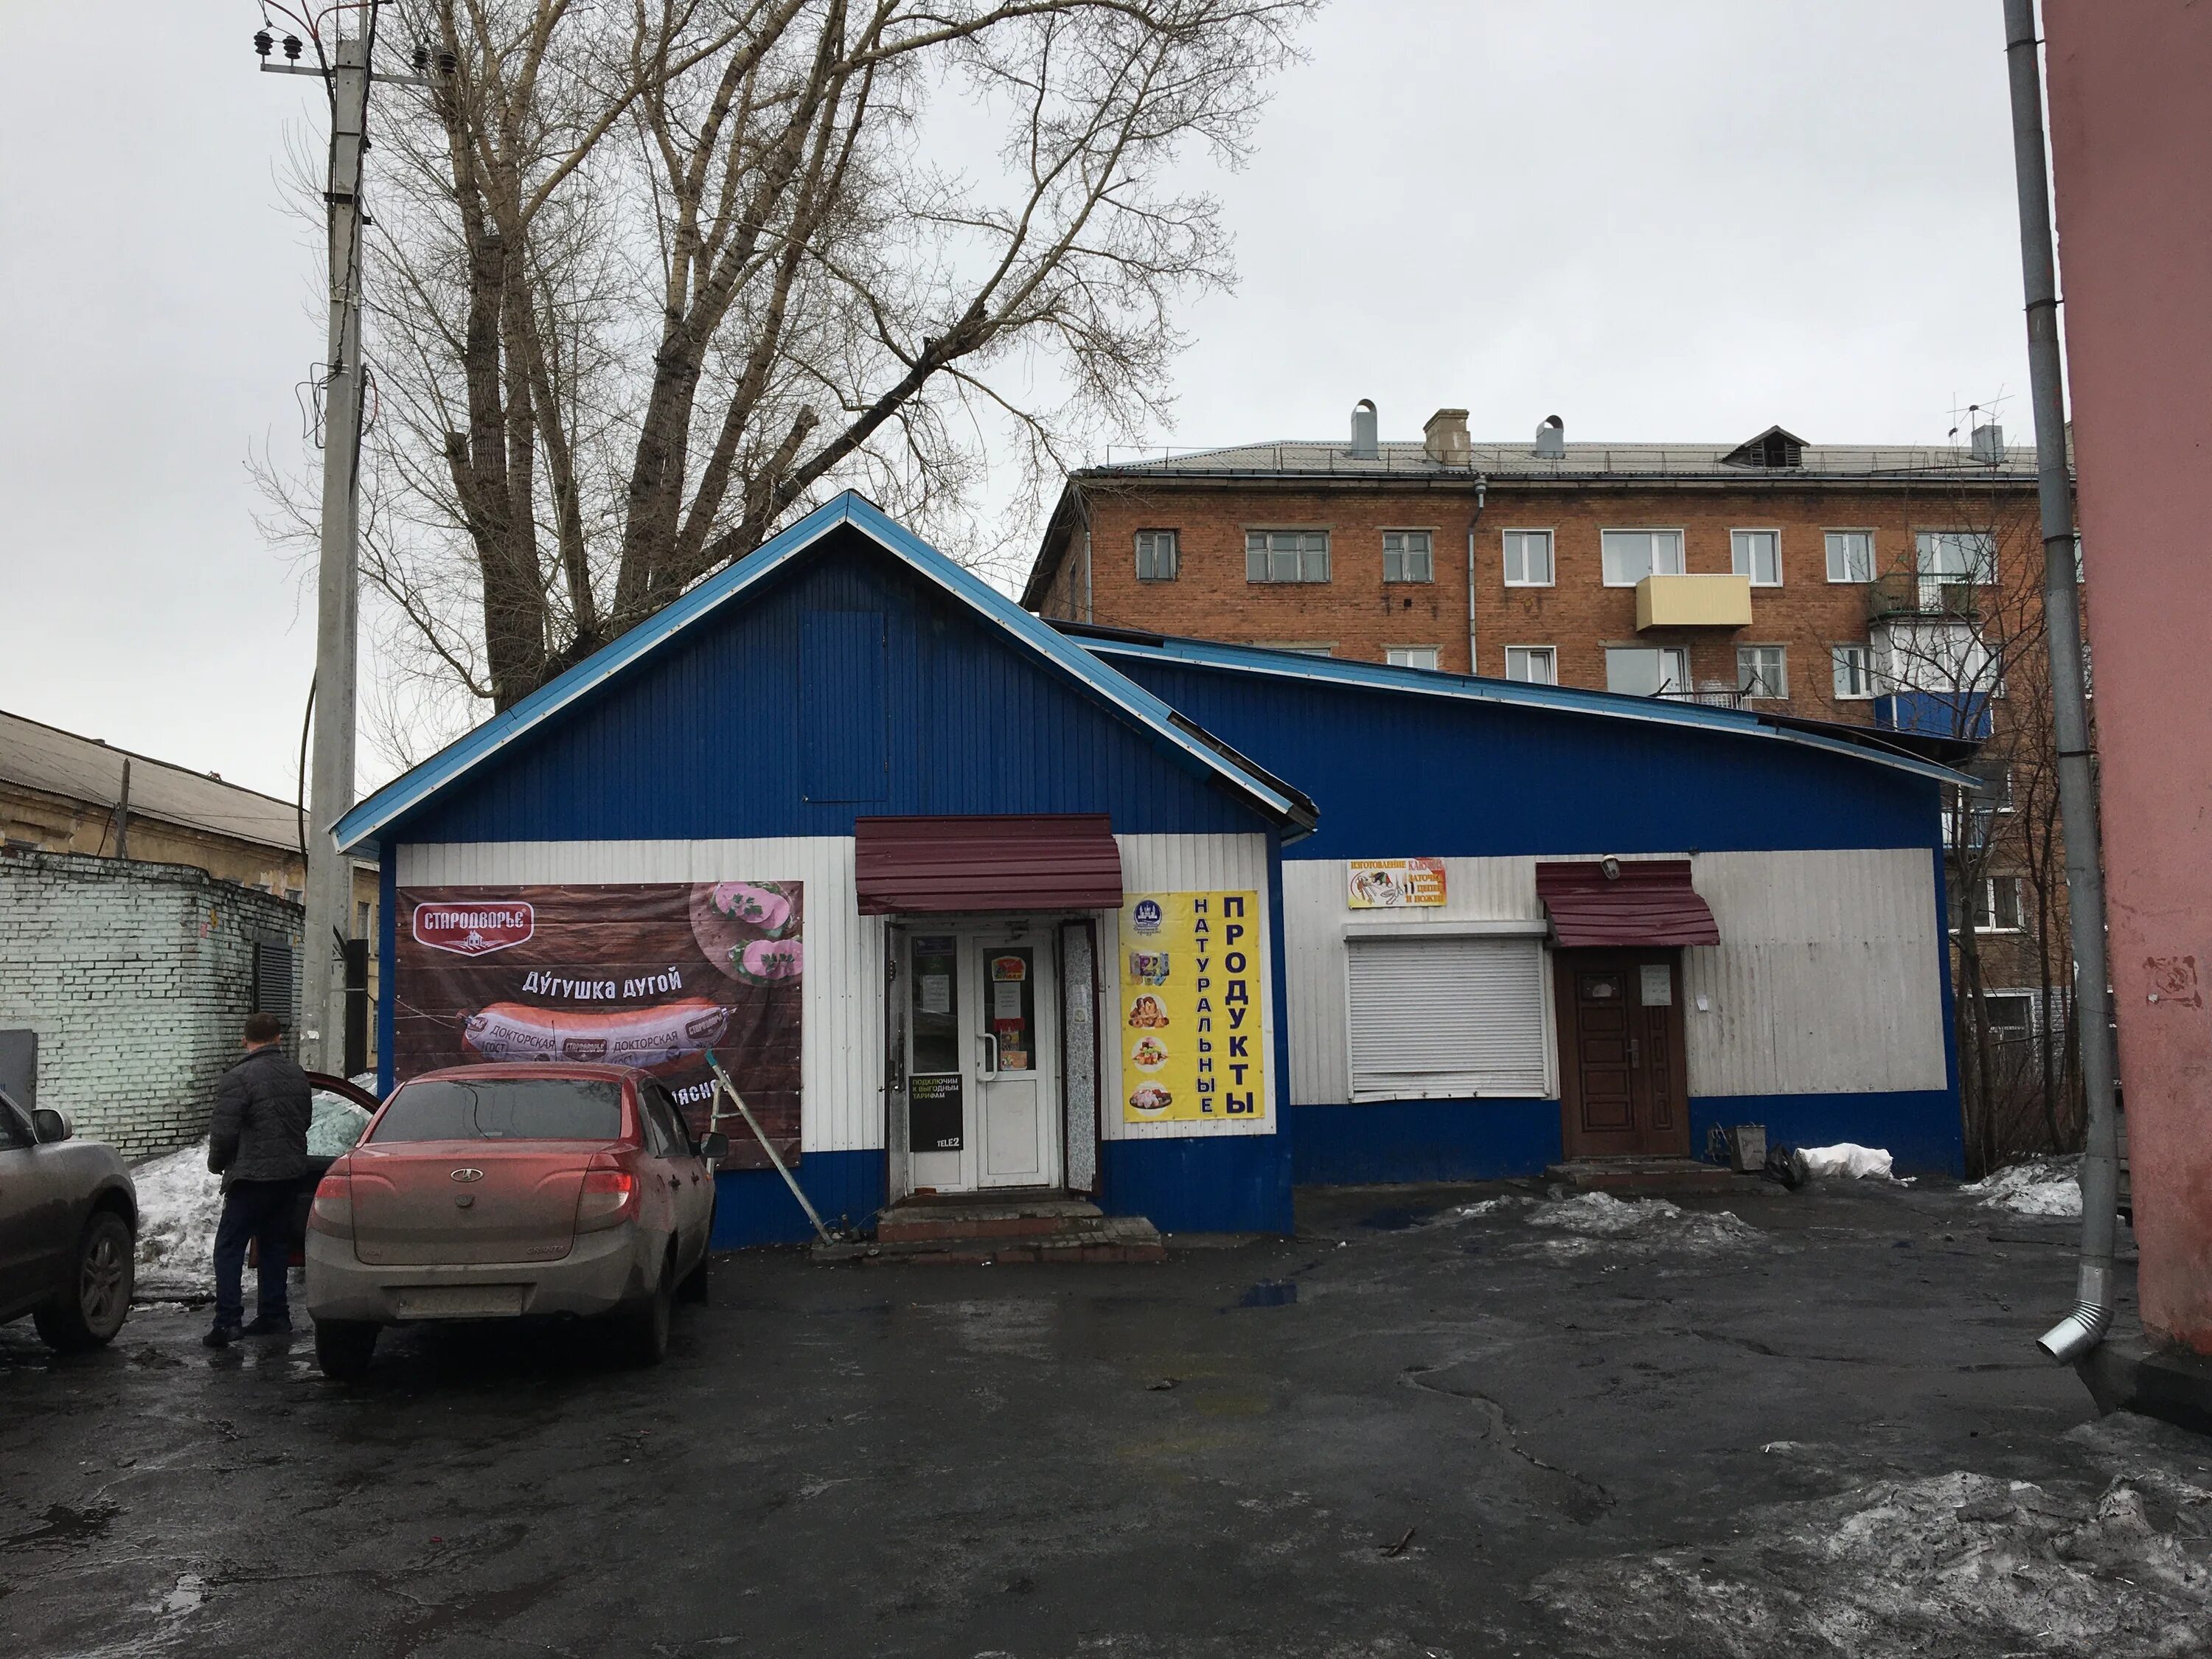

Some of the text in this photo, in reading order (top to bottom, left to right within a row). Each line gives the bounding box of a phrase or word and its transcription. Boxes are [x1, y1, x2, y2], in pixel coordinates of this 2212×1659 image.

[1351, 860, 1405, 869] ИЗГОТОВЛЕНИЕ
[1406, 895, 1412, 903] И
[424, 911, 524, 930] СТАРОДВОРЬЕ
[1194, 898, 1215, 1113] НАТУРАЛЬНЫЕ
[1223, 897, 1253, 1114] ПРОДУКТЫ
[490, 1025, 555, 1049] ДОКТОРСКАЯ
[613, 1031, 678, 1054] ДОКТОРСКАЯ
[484, 1042, 507, 1053] ГОСТ
[936, 1137, 959, 1147] TELE2
